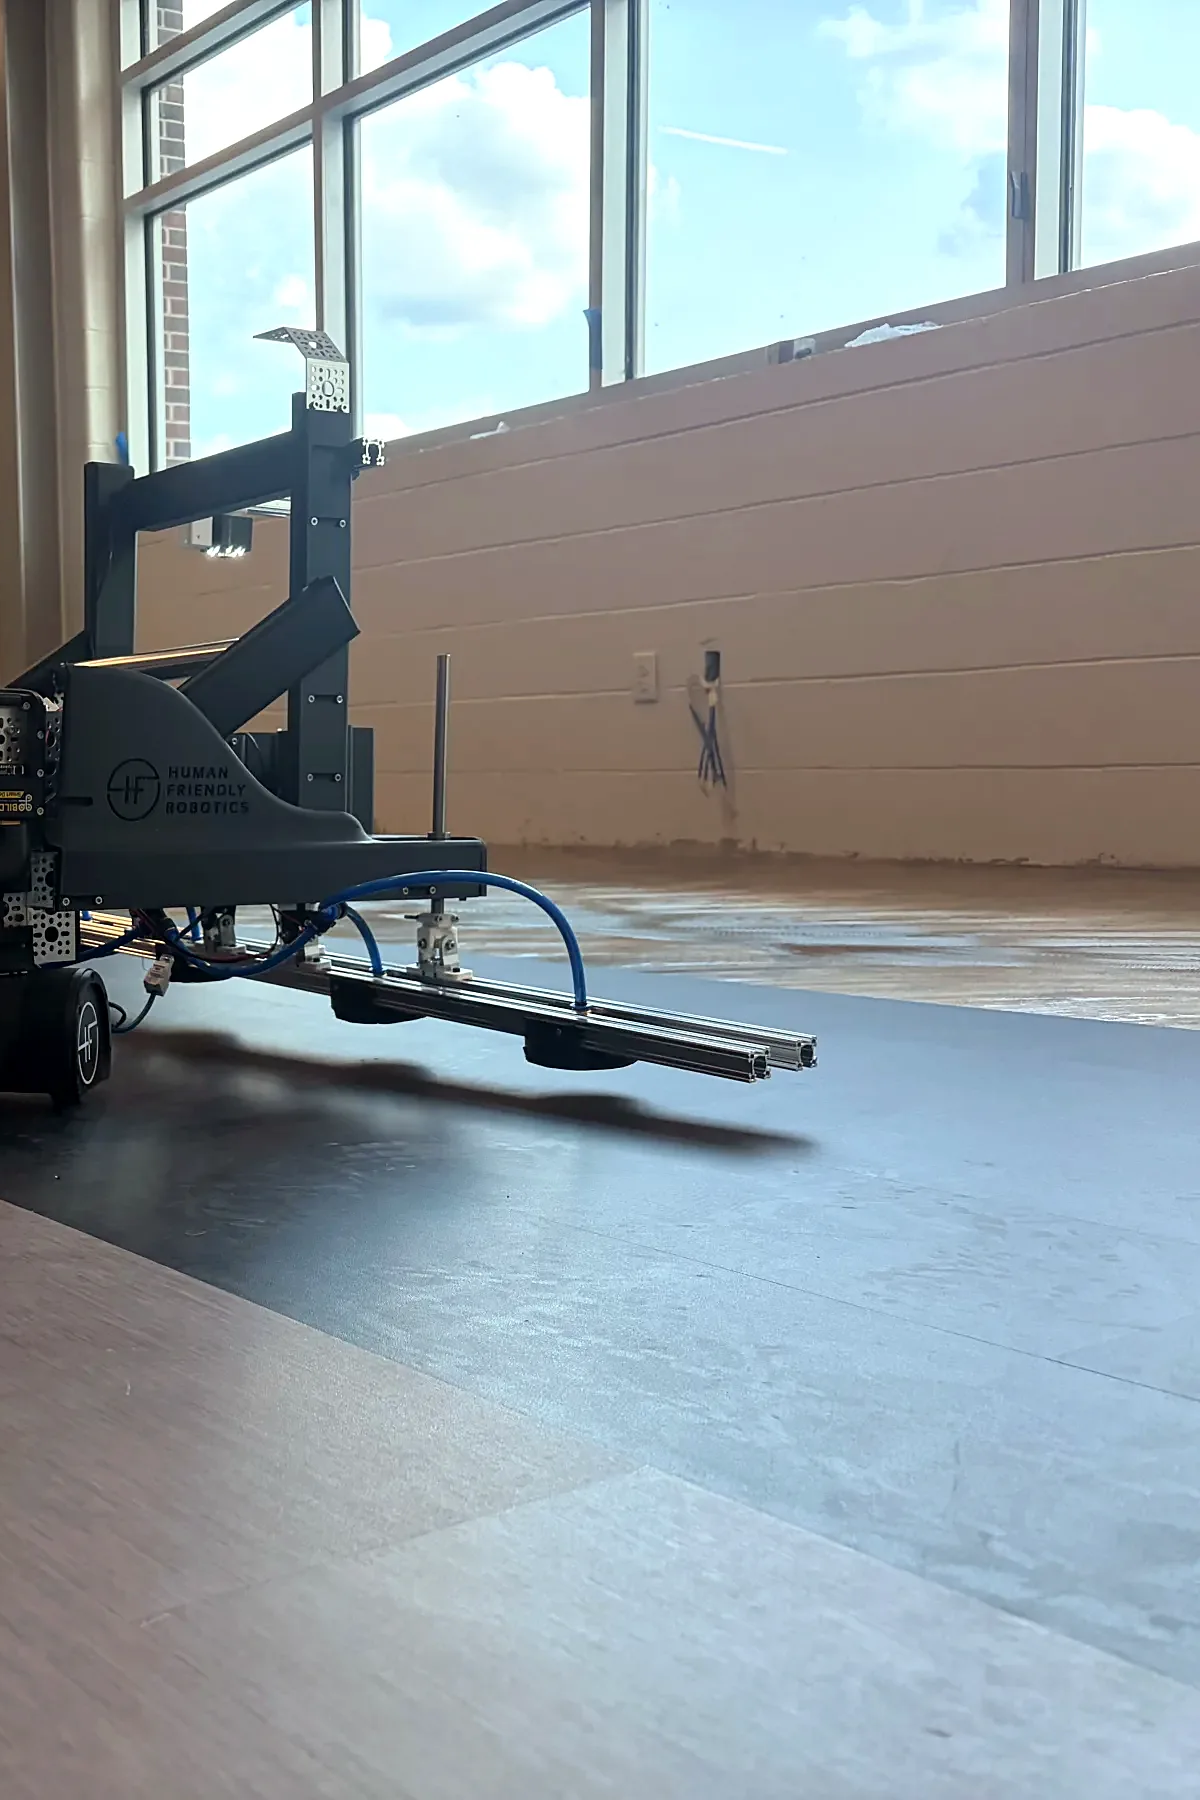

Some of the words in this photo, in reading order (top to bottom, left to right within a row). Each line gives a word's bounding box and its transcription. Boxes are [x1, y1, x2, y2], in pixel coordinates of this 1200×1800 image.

[168, 766, 228, 779] HUMAN
[166, 784, 247, 797] FRIENDLY
[165, 801, 250, 814] ROBOTICS
